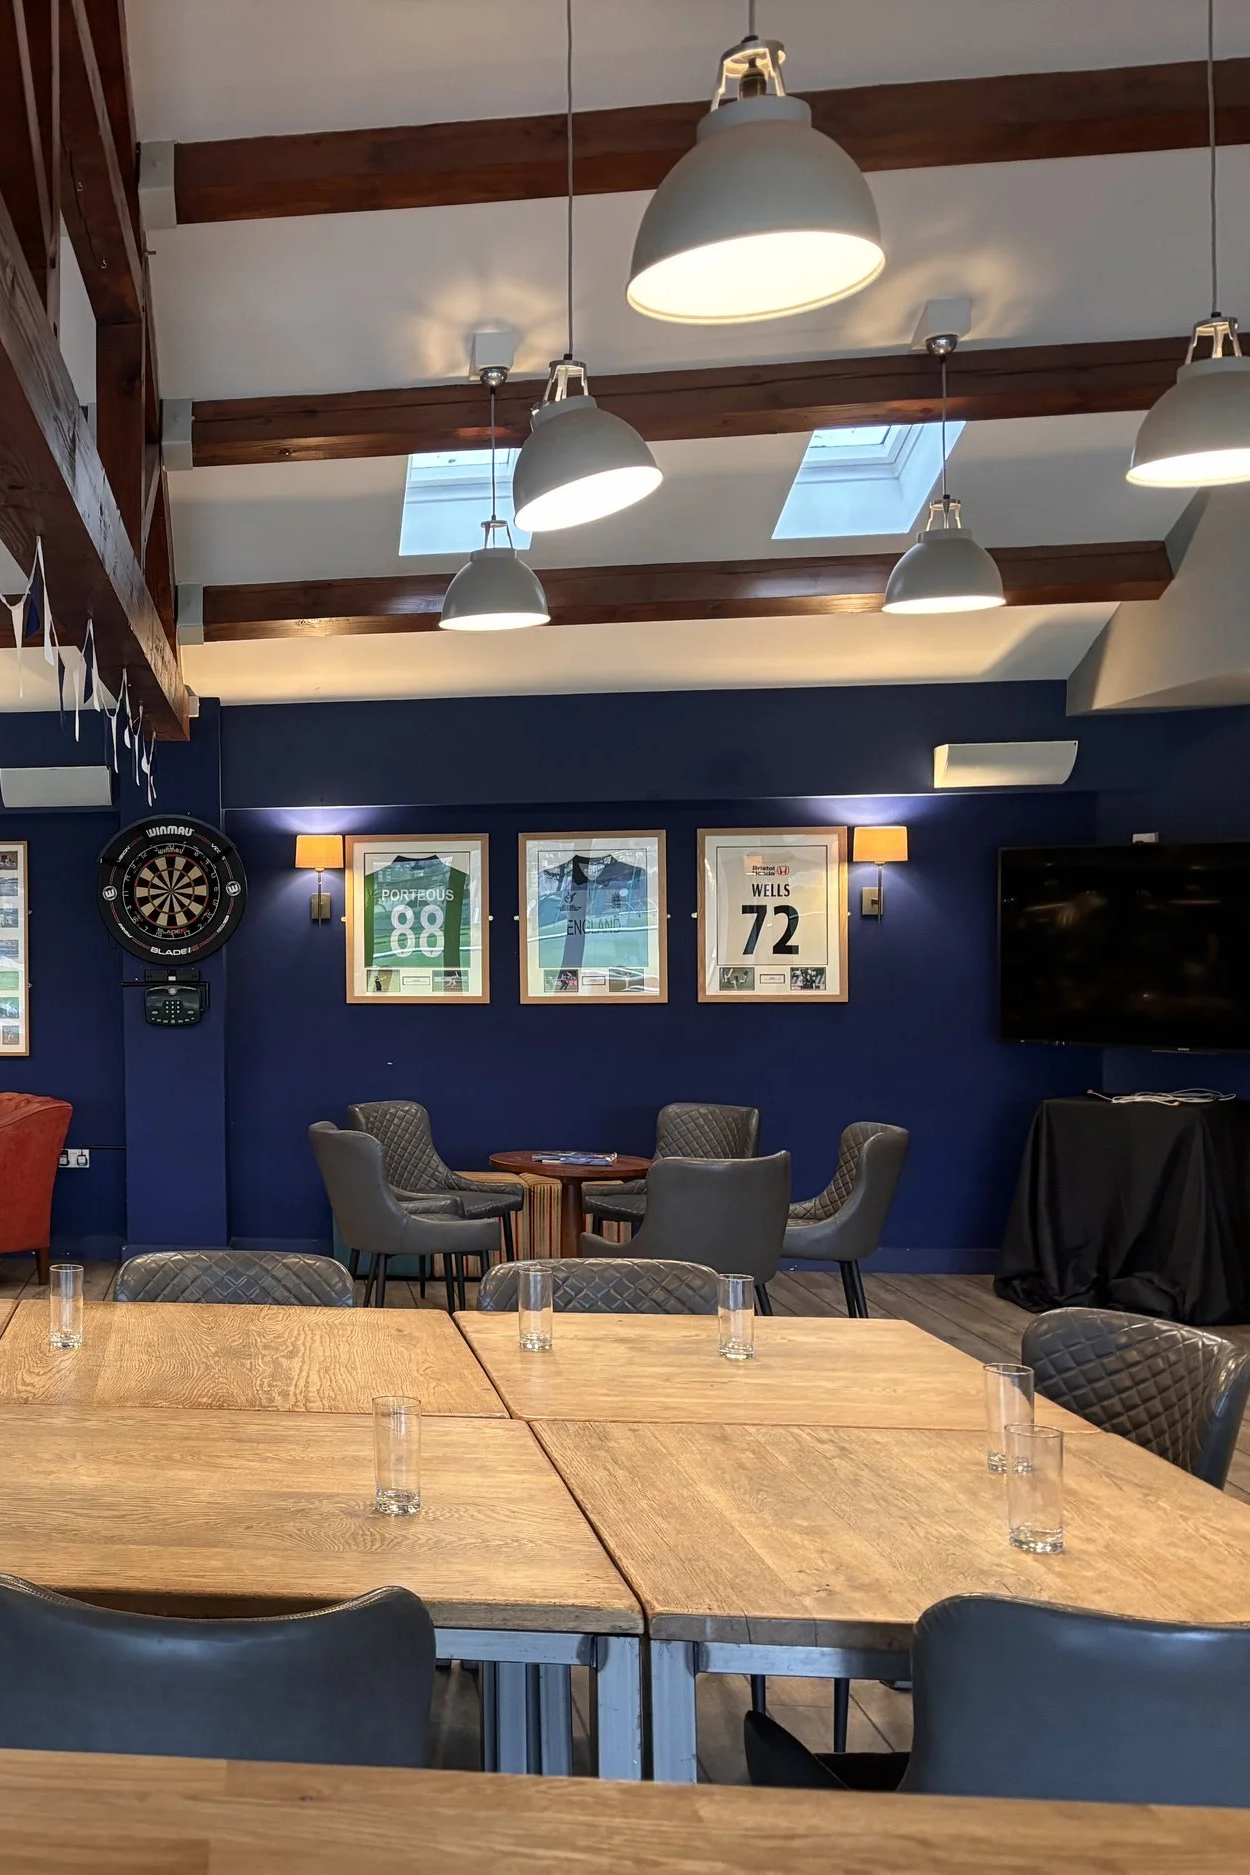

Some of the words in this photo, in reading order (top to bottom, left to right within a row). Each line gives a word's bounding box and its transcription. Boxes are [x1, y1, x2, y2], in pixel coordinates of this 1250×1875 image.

[146, 825, 195, 838] WINMAU
[381, 889, 455, 902] PORTEOUS
[751, 883, 791, 898] WELLS
[390, 904, 445, 958] 88
[566, 919, 622, 936] ENGLAND
[741, 904, 800, 955] 72
[150, 946, 187, 956] BLADE
